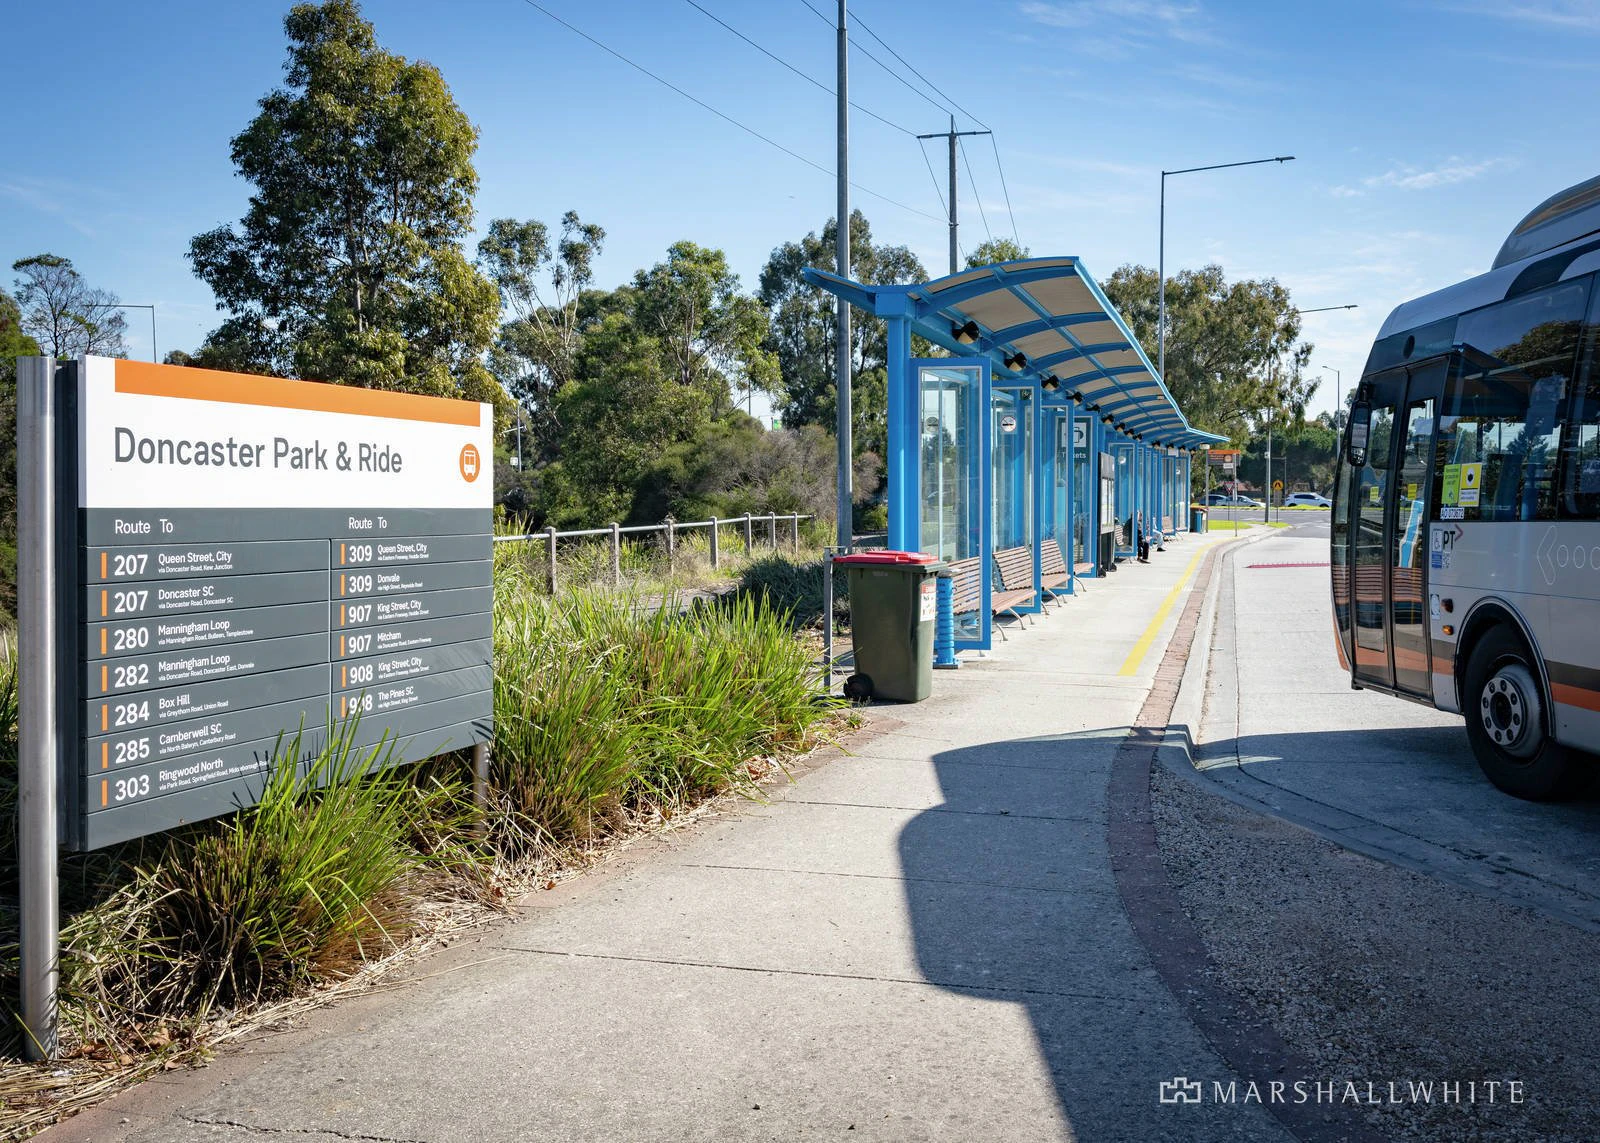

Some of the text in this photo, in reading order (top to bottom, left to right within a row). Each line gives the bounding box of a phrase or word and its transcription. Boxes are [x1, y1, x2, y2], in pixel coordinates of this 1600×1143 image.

[114, 426, 402, 474] Doncaster Park & Ride
[115, 519, 173, 534] Route To
[348, 516, 387, 529] Route To
[377, 543, 427, 555] Queen Street, City
[1443, 531, 1456, 550] PT
[158, 551, 232, 565] Queen Street, City
[349, 545, 372, 562] 309
[114, 554, 148, 576] 207
[349, 575, 372, 593] 309
[377, 574, 400, 583] Donvale
[114, 591, 148, 613] 207
[158, 586, 214, 600] Doncaster SC
[348, 605, 372, 623] 907
[377, 603, 390, 613] King
[410, 600, 422, 610] City
[158, 620, 230, 636] Manningham Loop
[377, 632, 401, 642] Mitcham
[114, 627, 149, 650] 280
[348, 635, 372, 653] 907
[158, 654, 231, 672] Manningham Loop
[378, 662, 391, 672] King
[411, 657, 422, 667] City
[114, 664, 149, 688] 282
[350, 664, 373, 684] 908
[159, 694, 190, 709] Box Hill
[378, 686, 414, 701] The Pines SC
[114, 701, 150, 726] 284
[159, 723, 222, 745] Camberwell SC
[115, 738, 150, 764] 285
[159, 758, 224, 782] Ringwood North
[115, 775, 150, 801] 303
